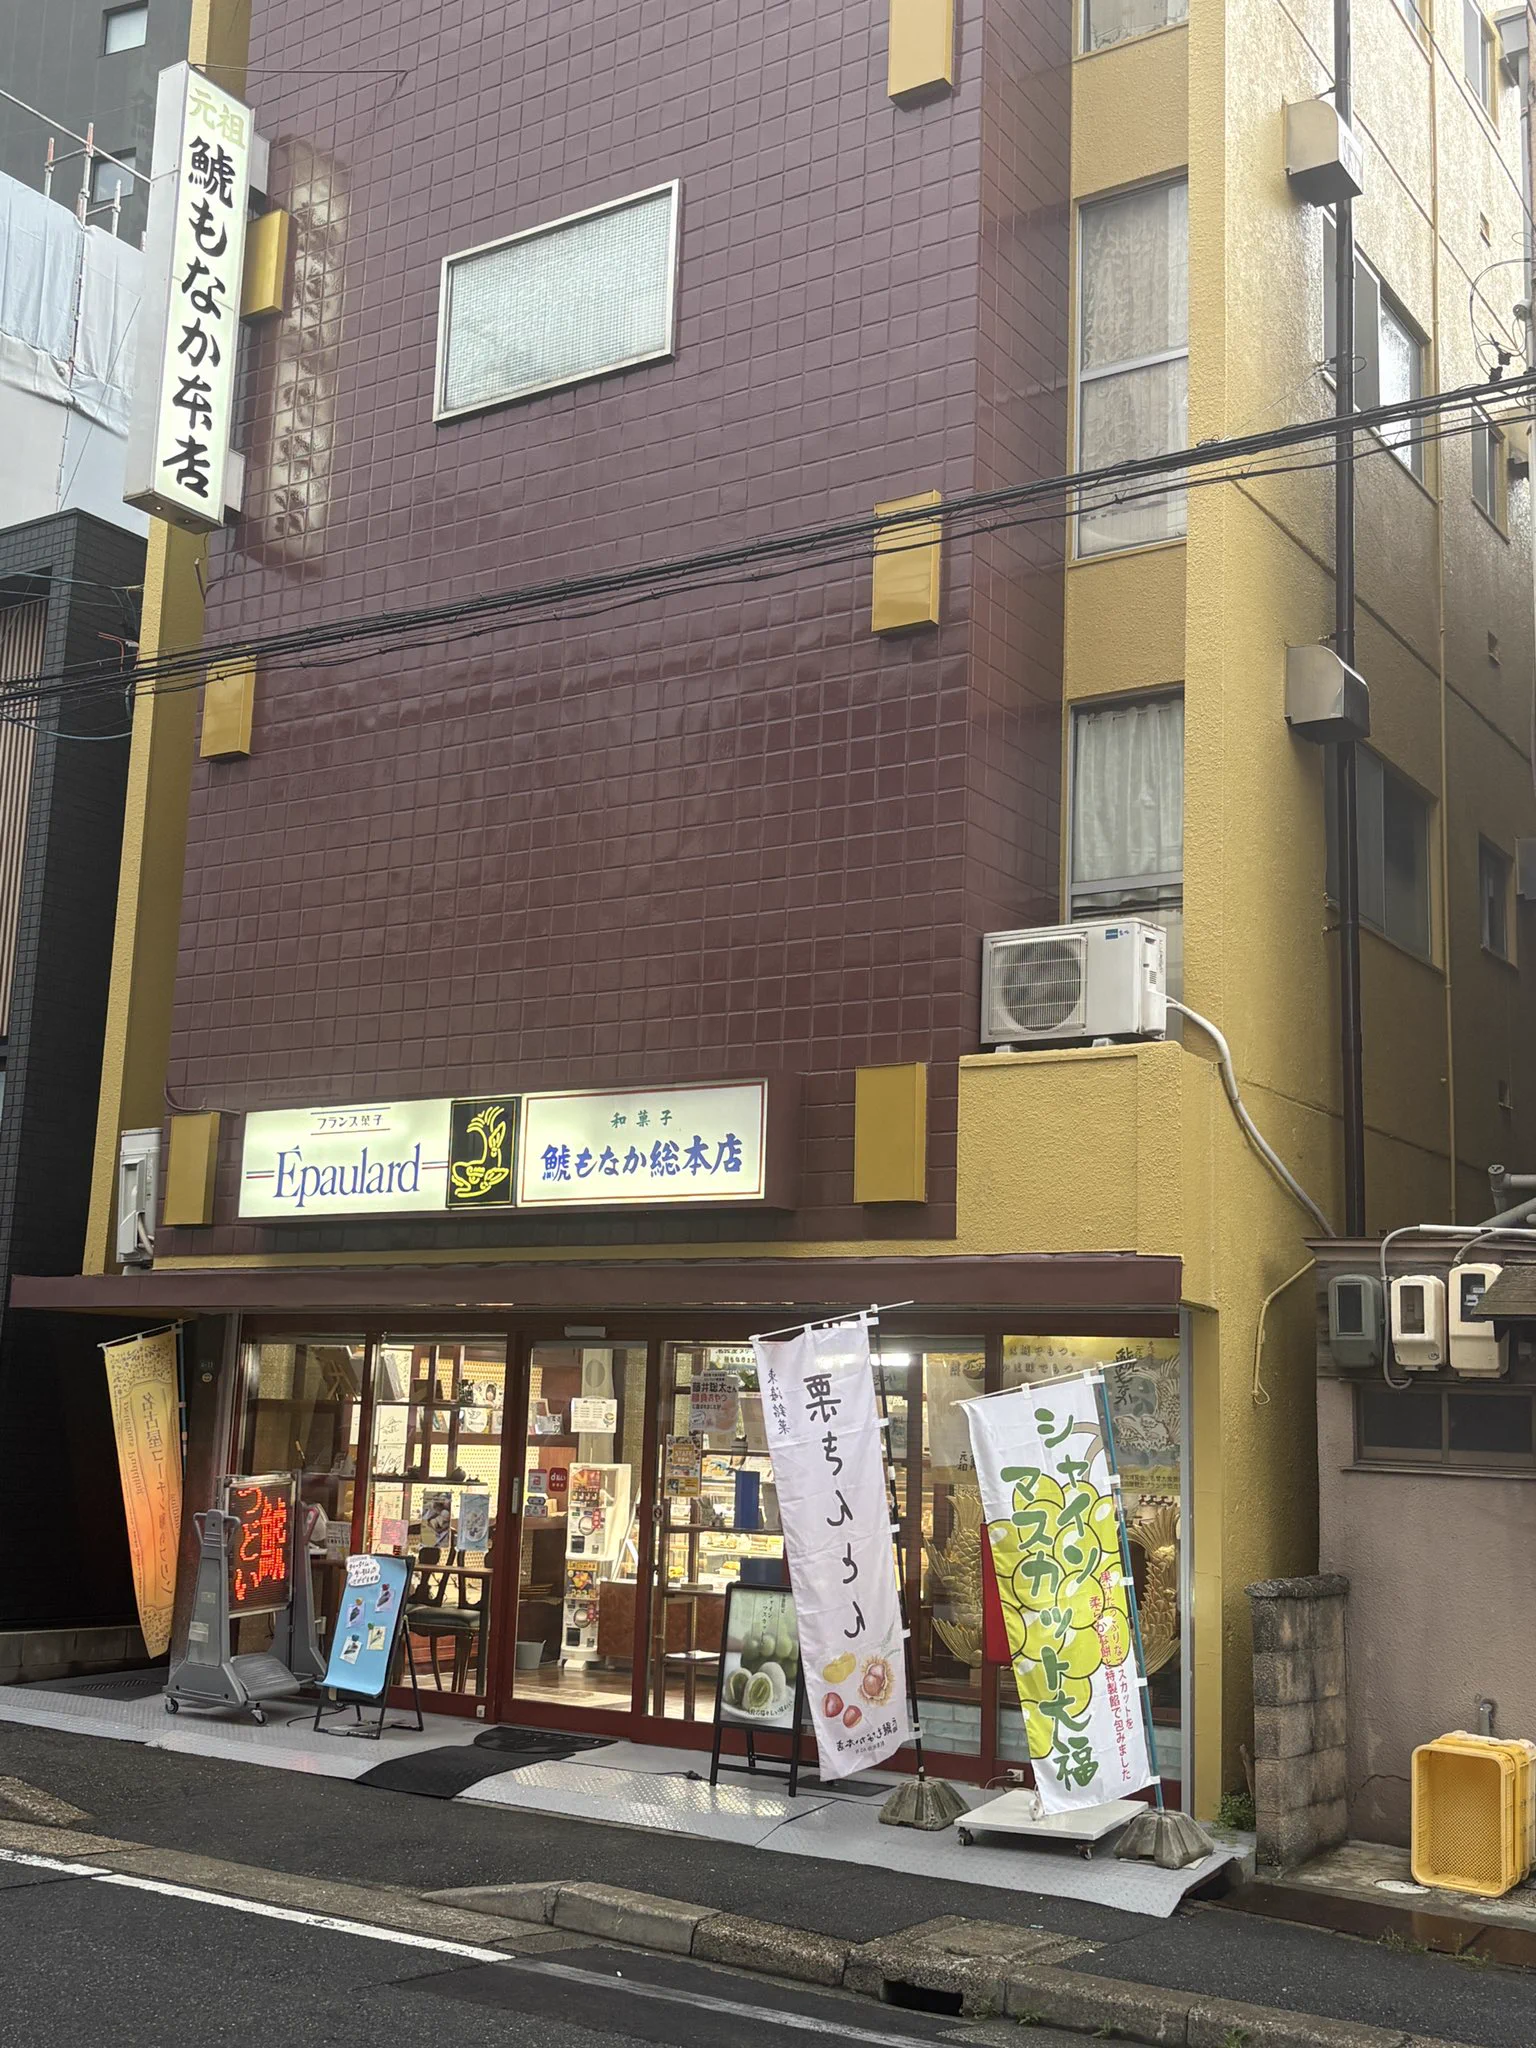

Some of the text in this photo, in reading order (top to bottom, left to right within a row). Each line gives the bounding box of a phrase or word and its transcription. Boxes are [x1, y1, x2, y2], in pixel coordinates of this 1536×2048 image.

[188, 86, 247, 152] 元祖
[162, 134, 237, 499] 鯱もなか本店
[273, 1142, 421, 1207] Épaulard
[316, 1113, 384, 1129] フランス菓子
[540, 1133, 743, 1181] 鯱もなか総本店
[610, 1110, 674, 1128] 和菓子
[1034, 1407, 1099, 1586] シャイン
[1000, 1465, 1099, 1791] マスカット大福
[1099, 1571, 1134, 1730] 果汁たっぷりなマスカットを
[1089, 1595, 1132, 1781] 柔らかな餅と特製餡で包みました
